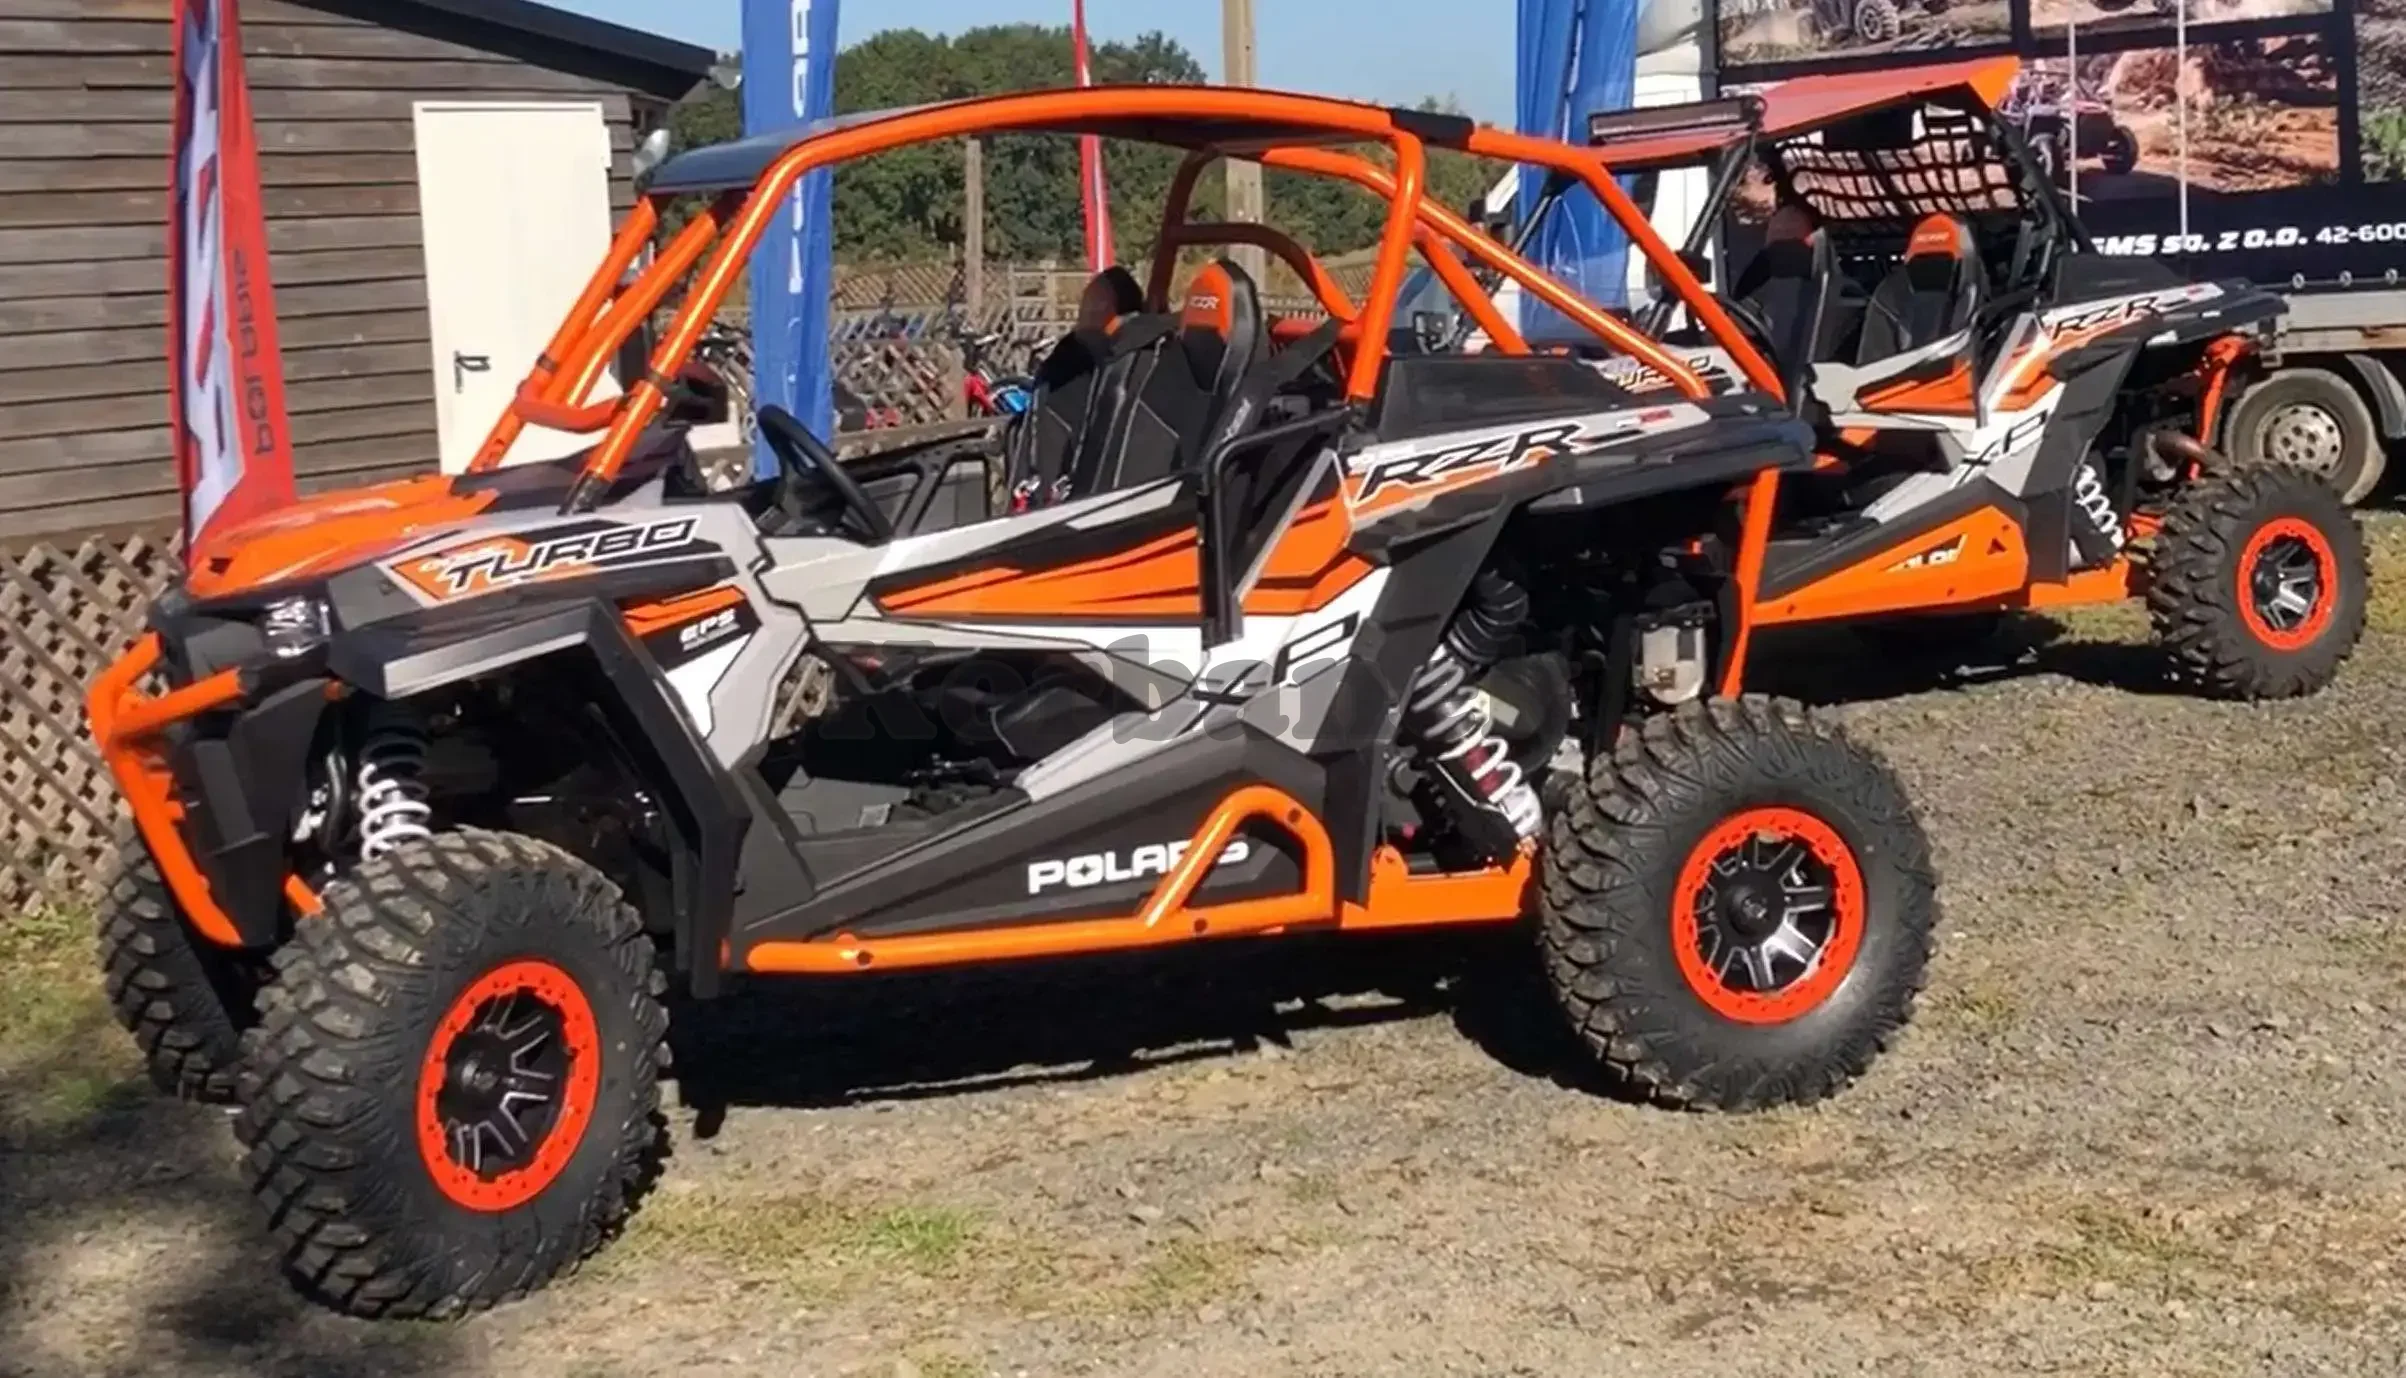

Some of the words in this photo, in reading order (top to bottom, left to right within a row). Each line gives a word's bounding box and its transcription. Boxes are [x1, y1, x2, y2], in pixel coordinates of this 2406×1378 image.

[2217, 230, 2239, 251] Z
[2316, 222, 2406, 245] 42-600
[1355, 421, 1583, 504] RZR
[440, 513, 700, 592] TURBO
